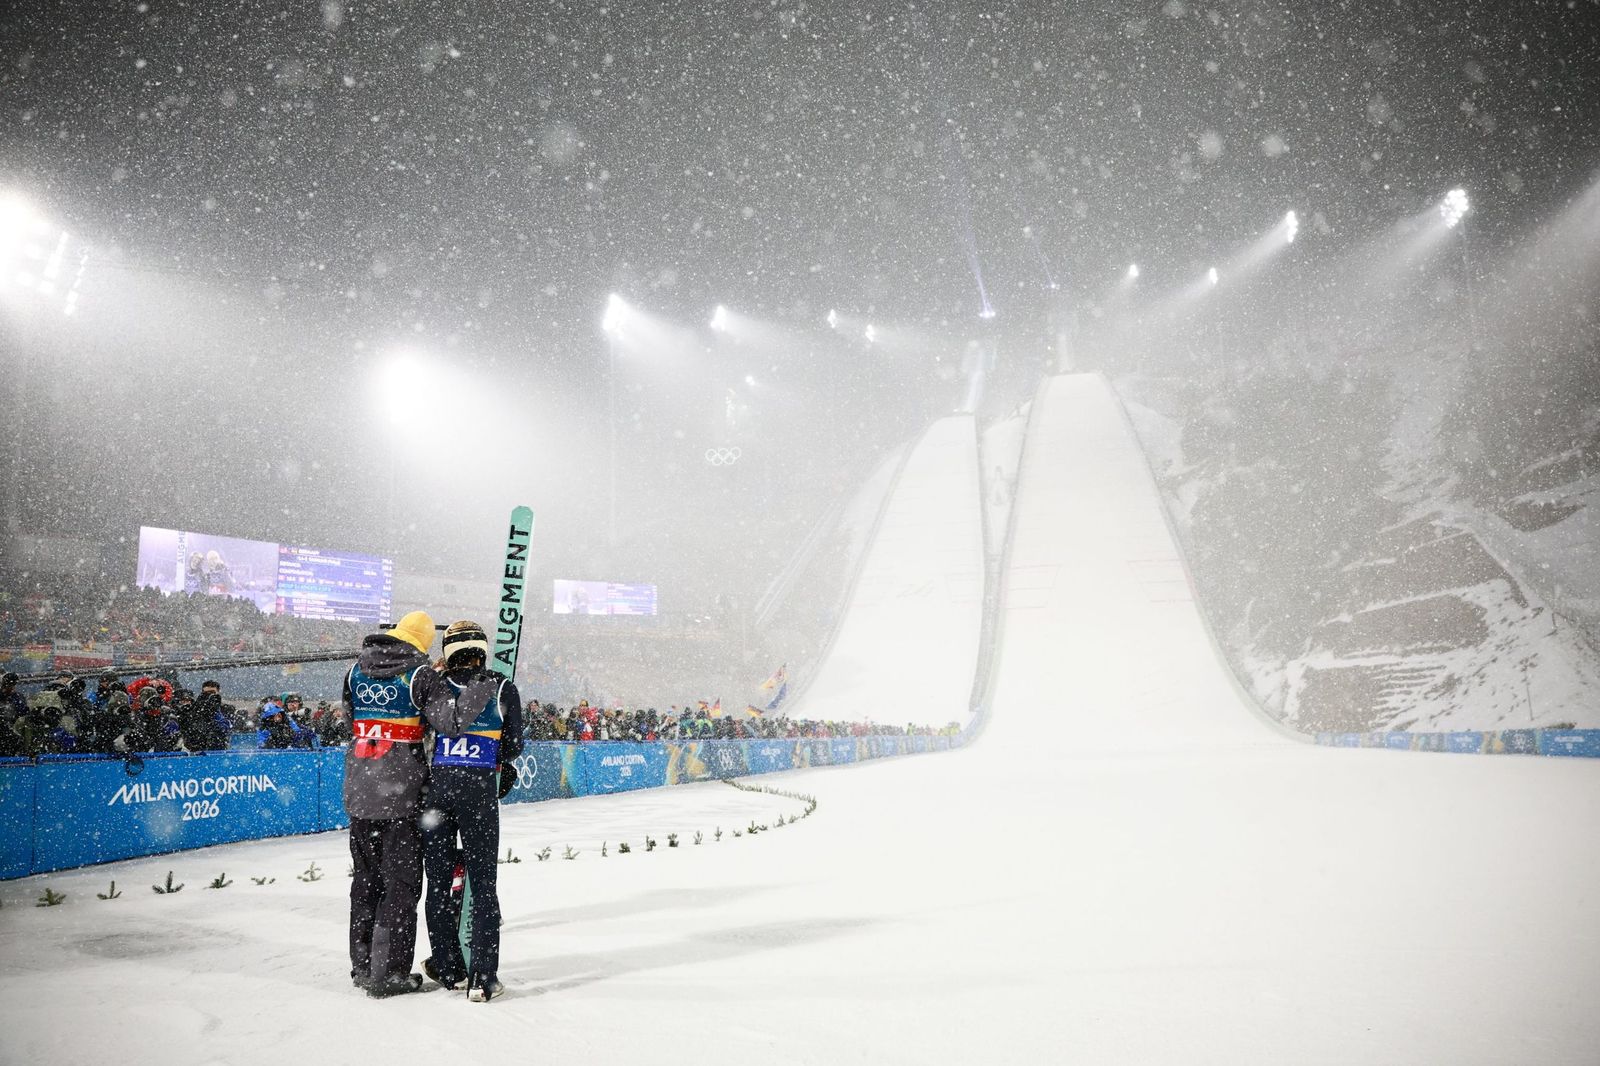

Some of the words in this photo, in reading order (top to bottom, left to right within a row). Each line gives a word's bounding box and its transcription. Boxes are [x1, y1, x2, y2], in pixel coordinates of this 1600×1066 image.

[494, 524, 529, 666] AUGMENT
[601, 755, 625, 767] MILANO
[107, 779, 199, 806] MILANO
[201, 774, 278, 797] CORTINA
[181, 798, 220, 822] 2026
